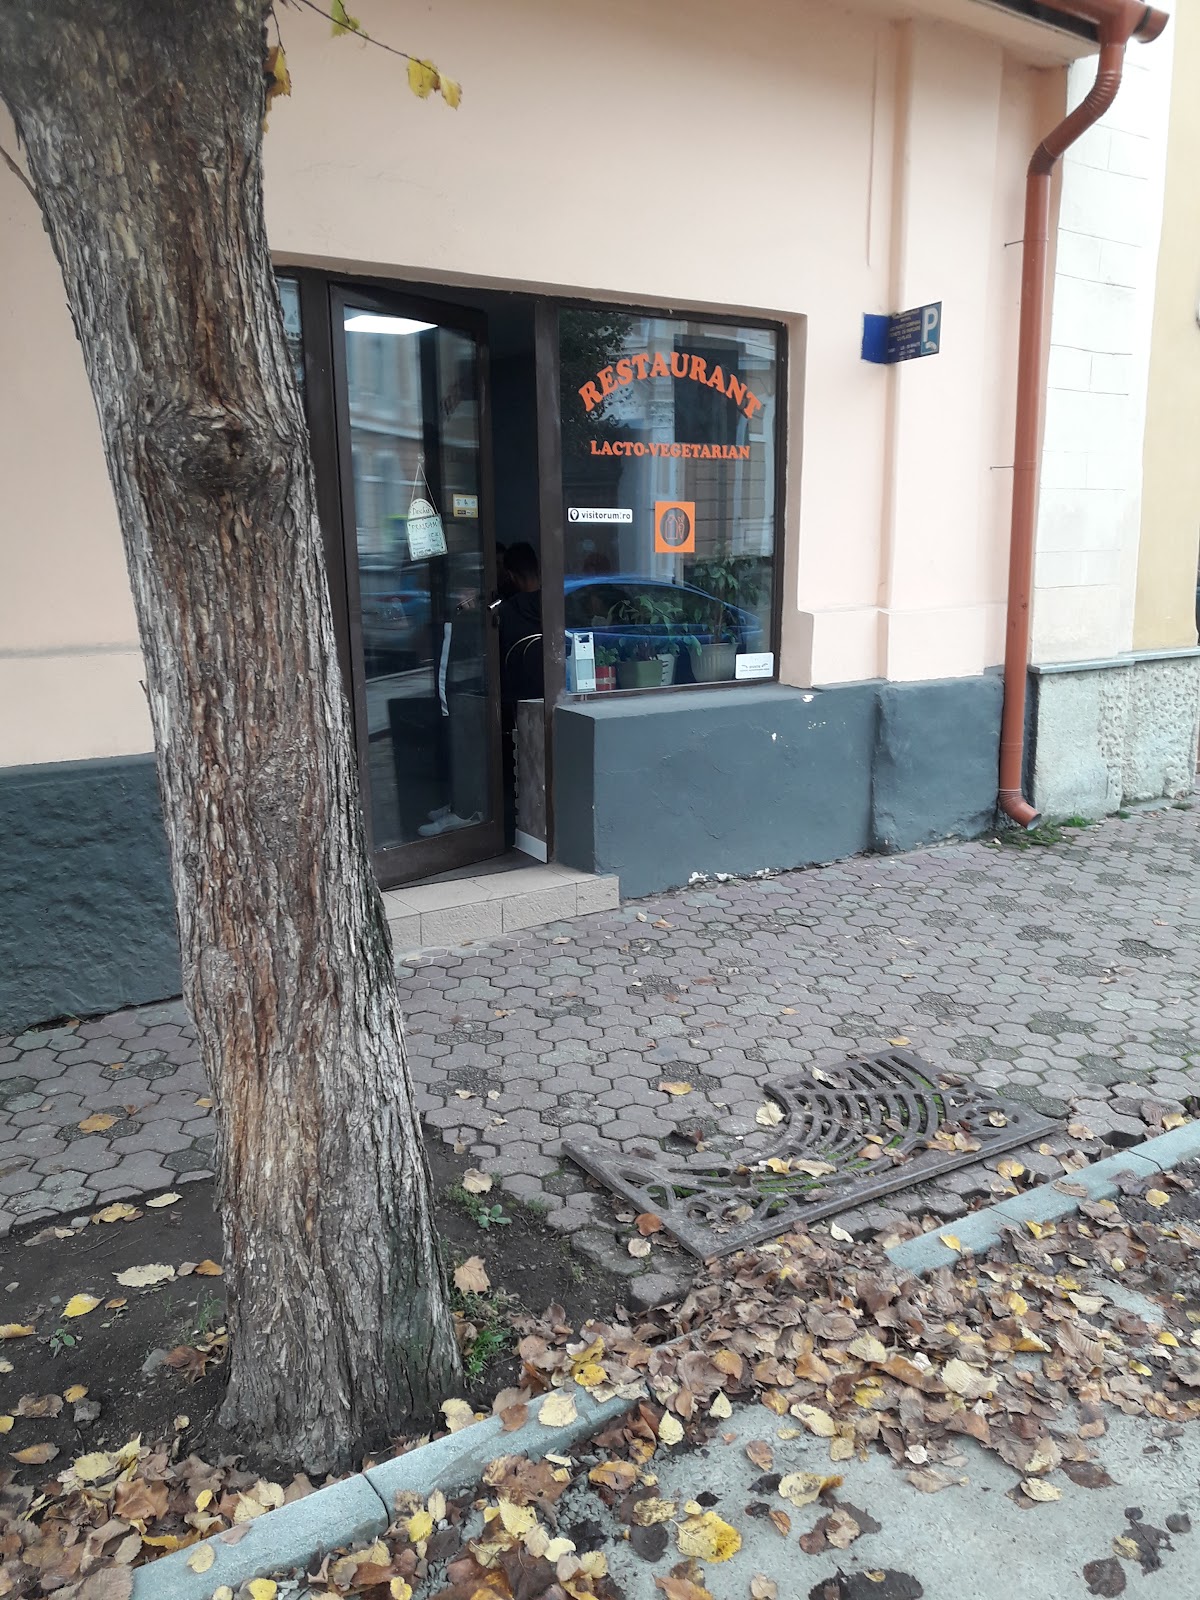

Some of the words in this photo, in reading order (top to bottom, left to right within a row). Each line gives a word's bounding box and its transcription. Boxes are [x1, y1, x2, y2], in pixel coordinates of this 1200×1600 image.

[924, 308, 938, 342] P
[579, 352, 761, 418] RESTAURANT
[590, 440, 750, 459] LACTO-VEGETARIAN
[580, 510, 631, 521] visitorum.ro
